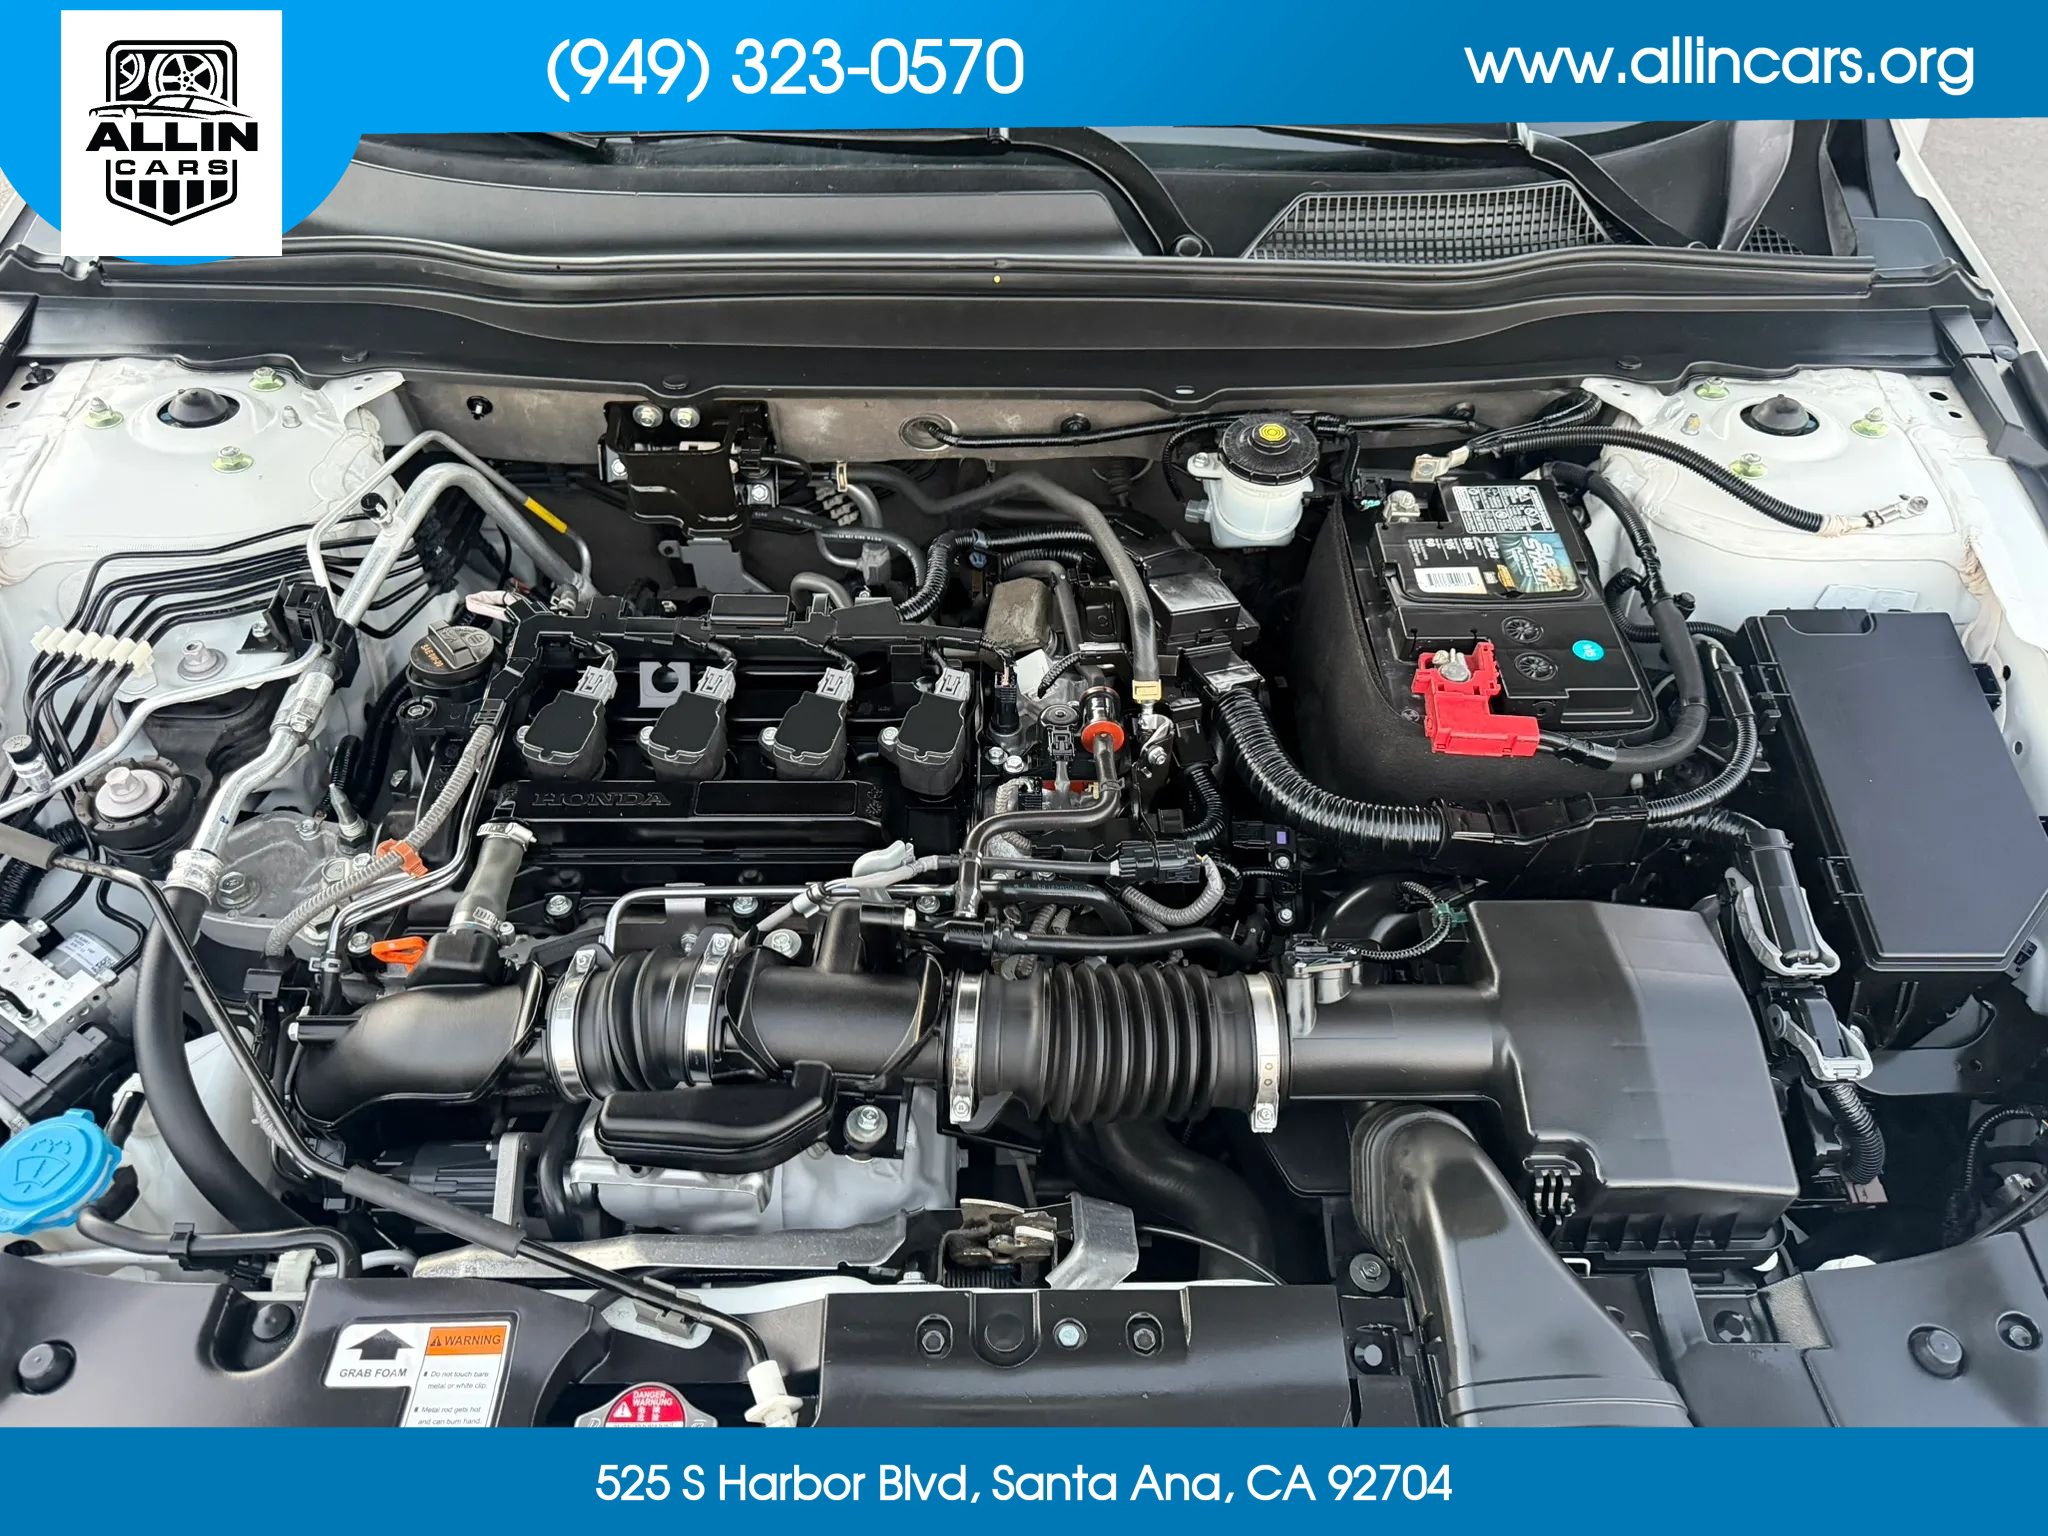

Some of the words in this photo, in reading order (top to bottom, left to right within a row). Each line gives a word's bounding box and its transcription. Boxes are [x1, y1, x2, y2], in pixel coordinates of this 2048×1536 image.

[1521, 536, 1548, 584] START
[532, 791, 671, 806] HONDA
[444, 1334, 502, 1346] WARNING
[339, 1368, 372, 1378] GRAB
[374, 1368, 408, 1378] FOAM
[632, 1390, 667, 1399] DANGER
[632, 1398, 673, 1407] WARNUNG
[453, 1407, 468, 1415] gets
